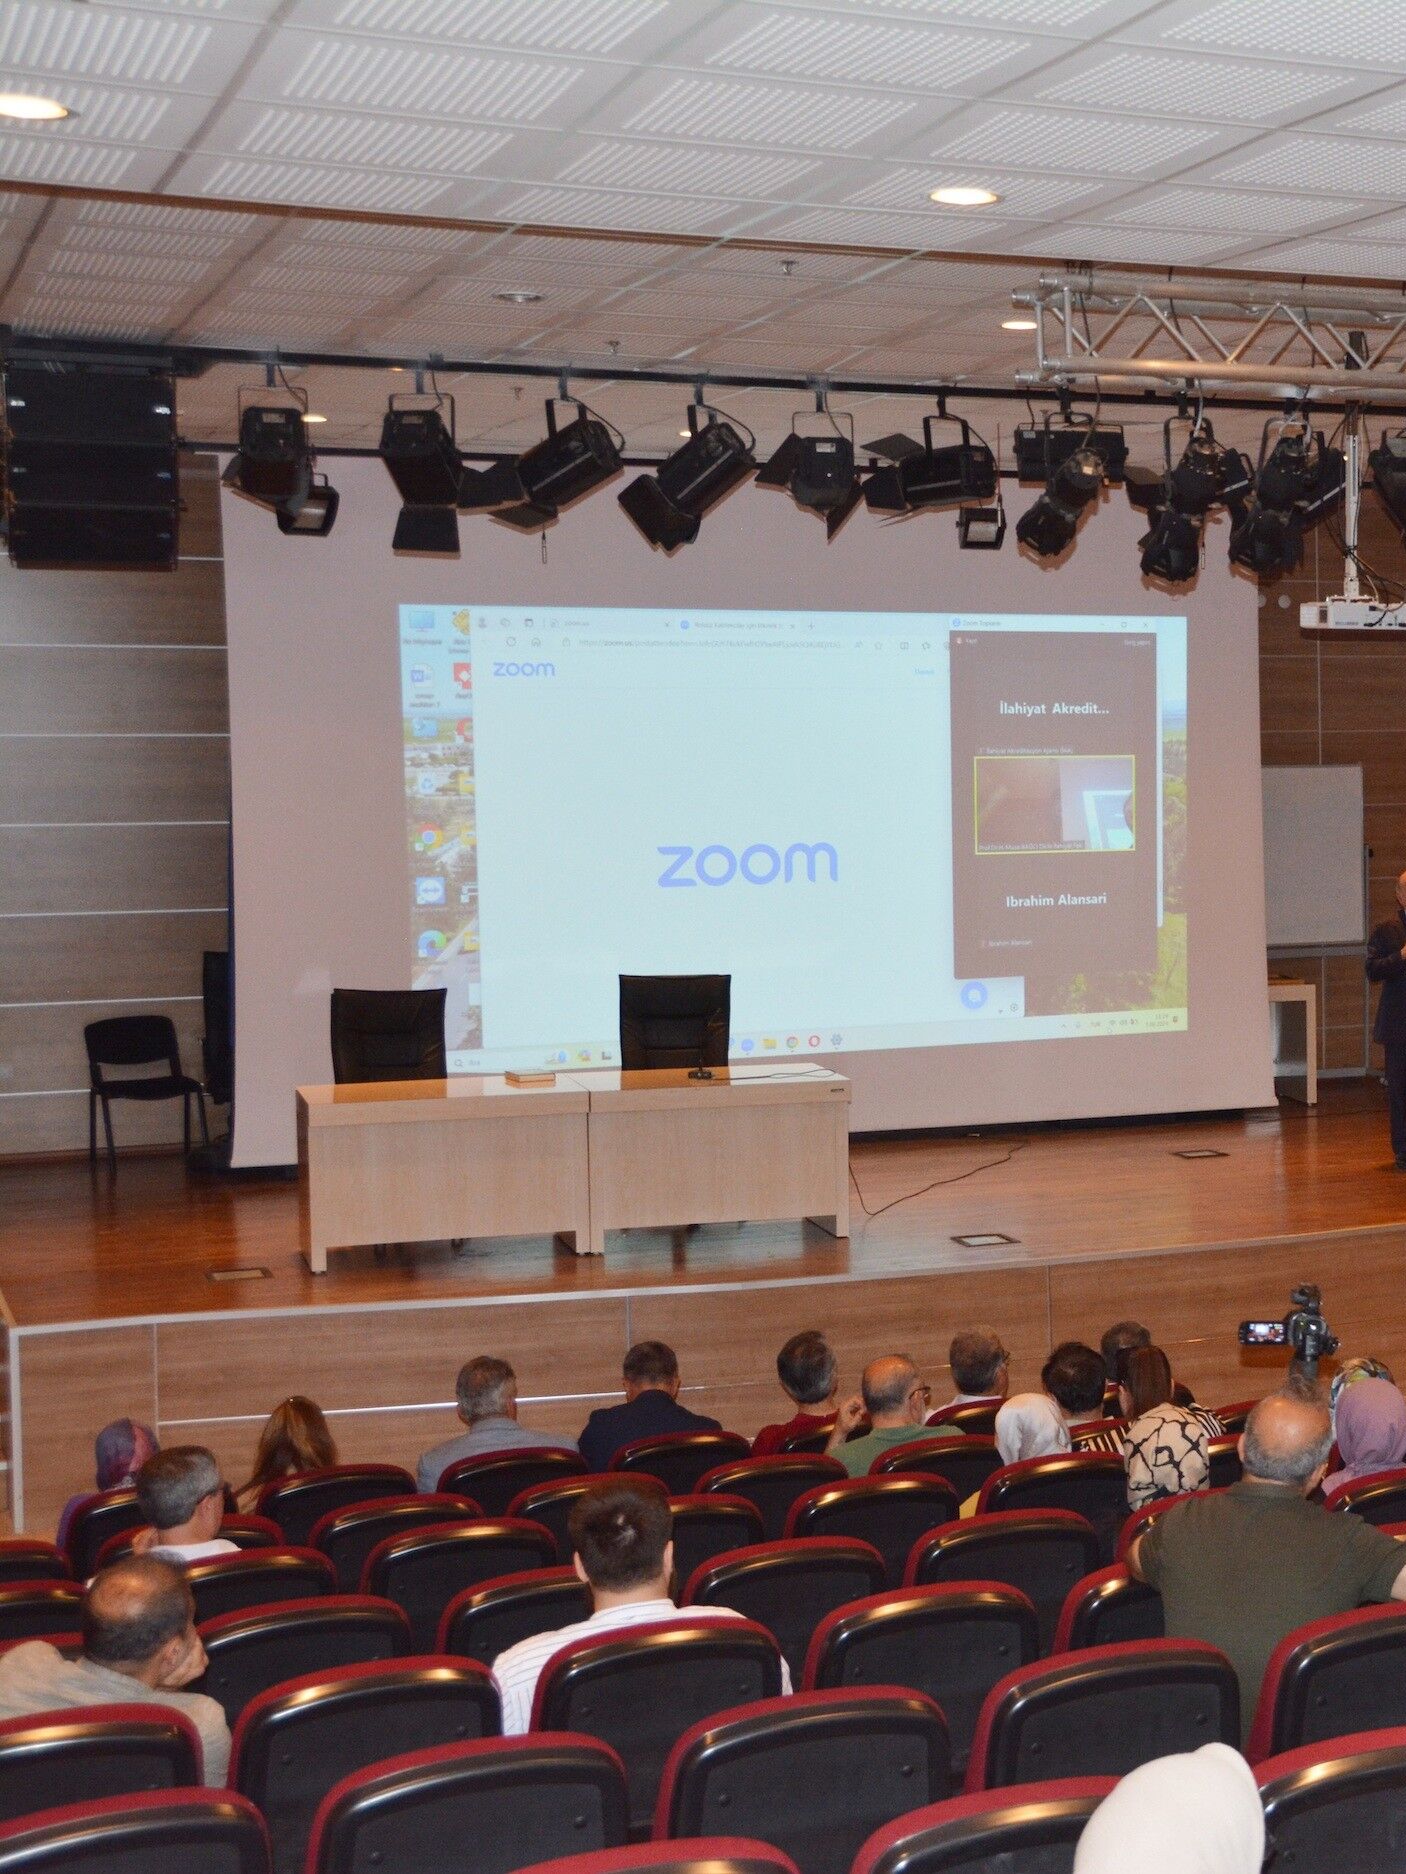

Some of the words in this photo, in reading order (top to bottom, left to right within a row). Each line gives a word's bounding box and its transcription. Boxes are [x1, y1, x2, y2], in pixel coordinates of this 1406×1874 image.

[493, 662, 555, 677] zoom
[657, 843, 839, 888] zoom
[1006, 894, 1054, 907] Ibrahim
[1058, 893, 1107, 906] Alansari
